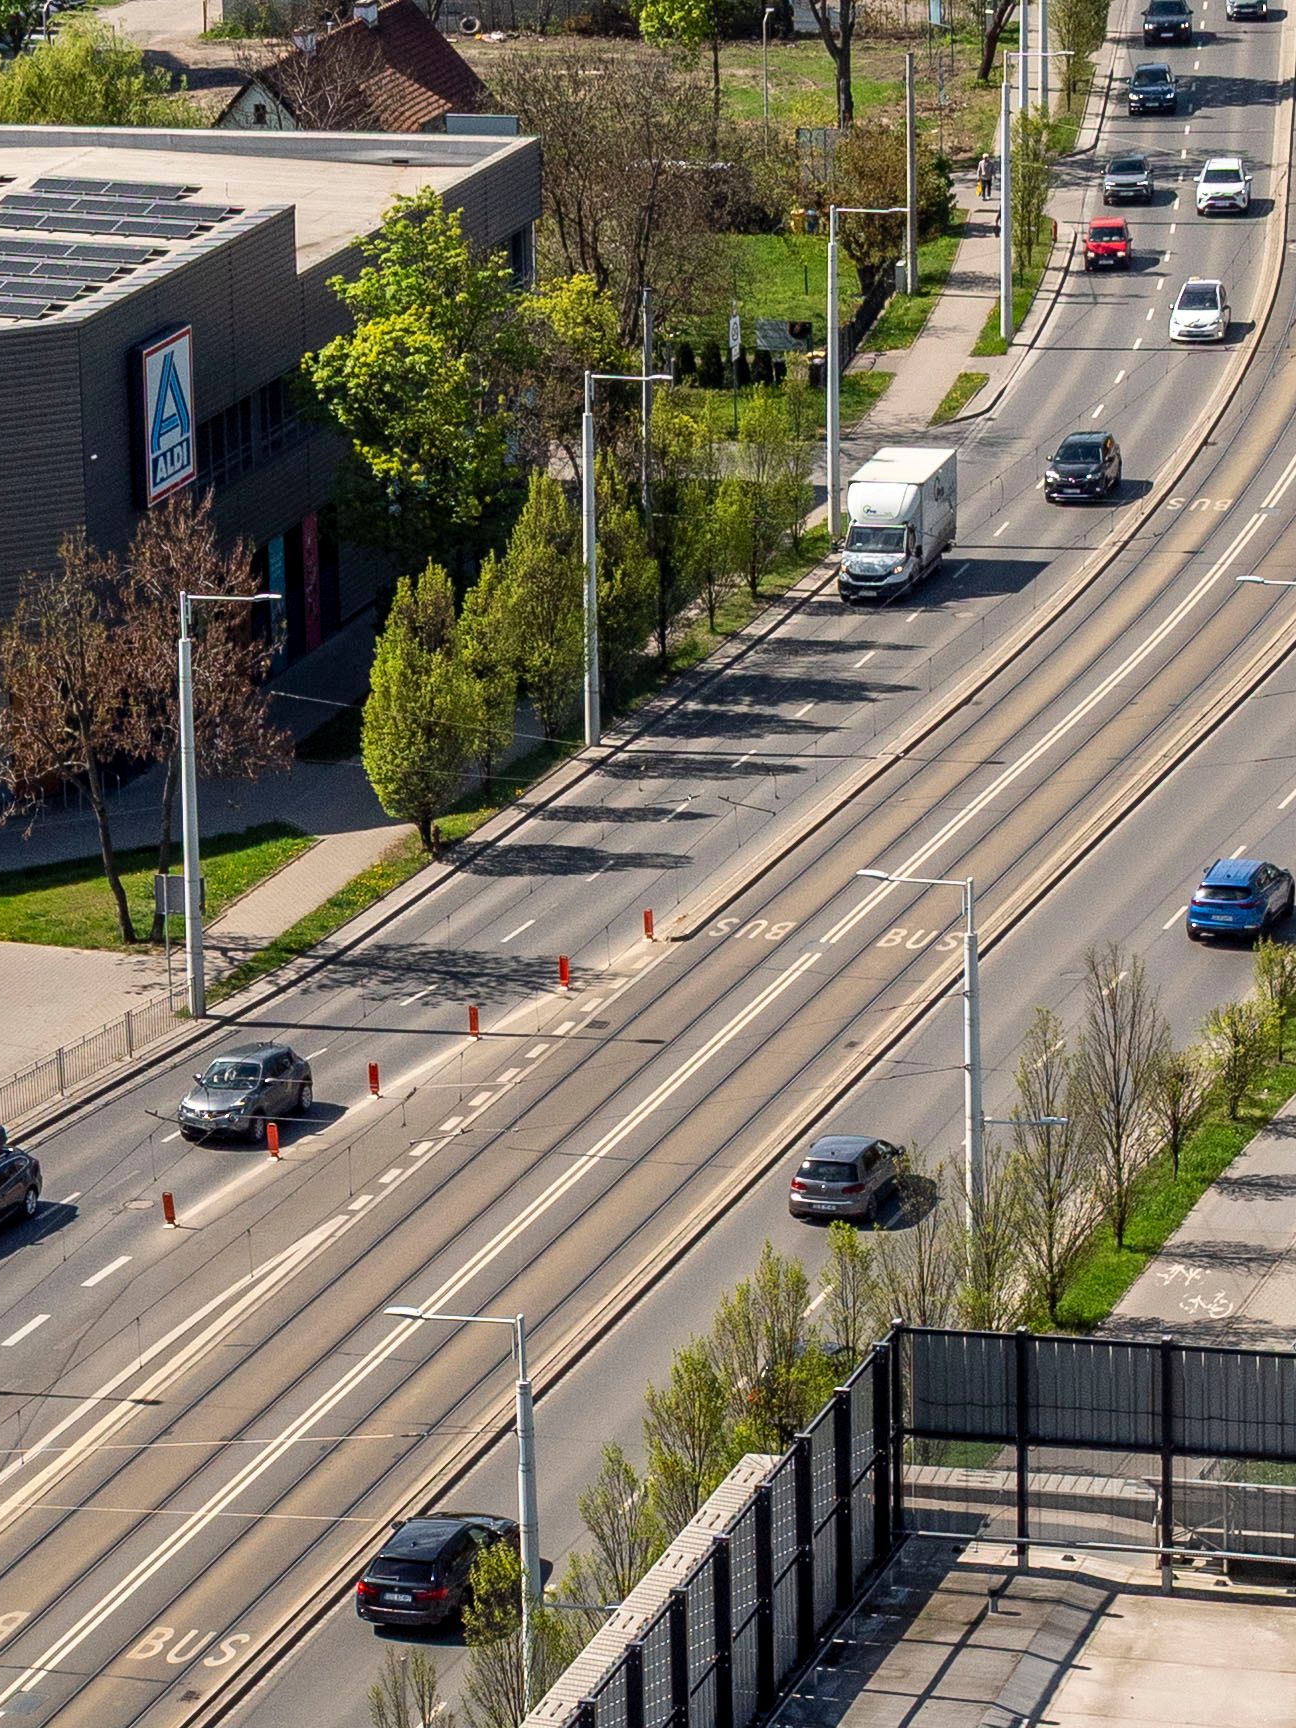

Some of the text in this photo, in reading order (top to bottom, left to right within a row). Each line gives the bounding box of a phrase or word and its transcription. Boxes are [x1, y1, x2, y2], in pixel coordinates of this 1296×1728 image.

[156, 440, 188, 483] ALDI
[709, 917, 798, 941] BUS
[876, 928, 965, 951] BUS
[125, 1626, 251, 1668] BUS
